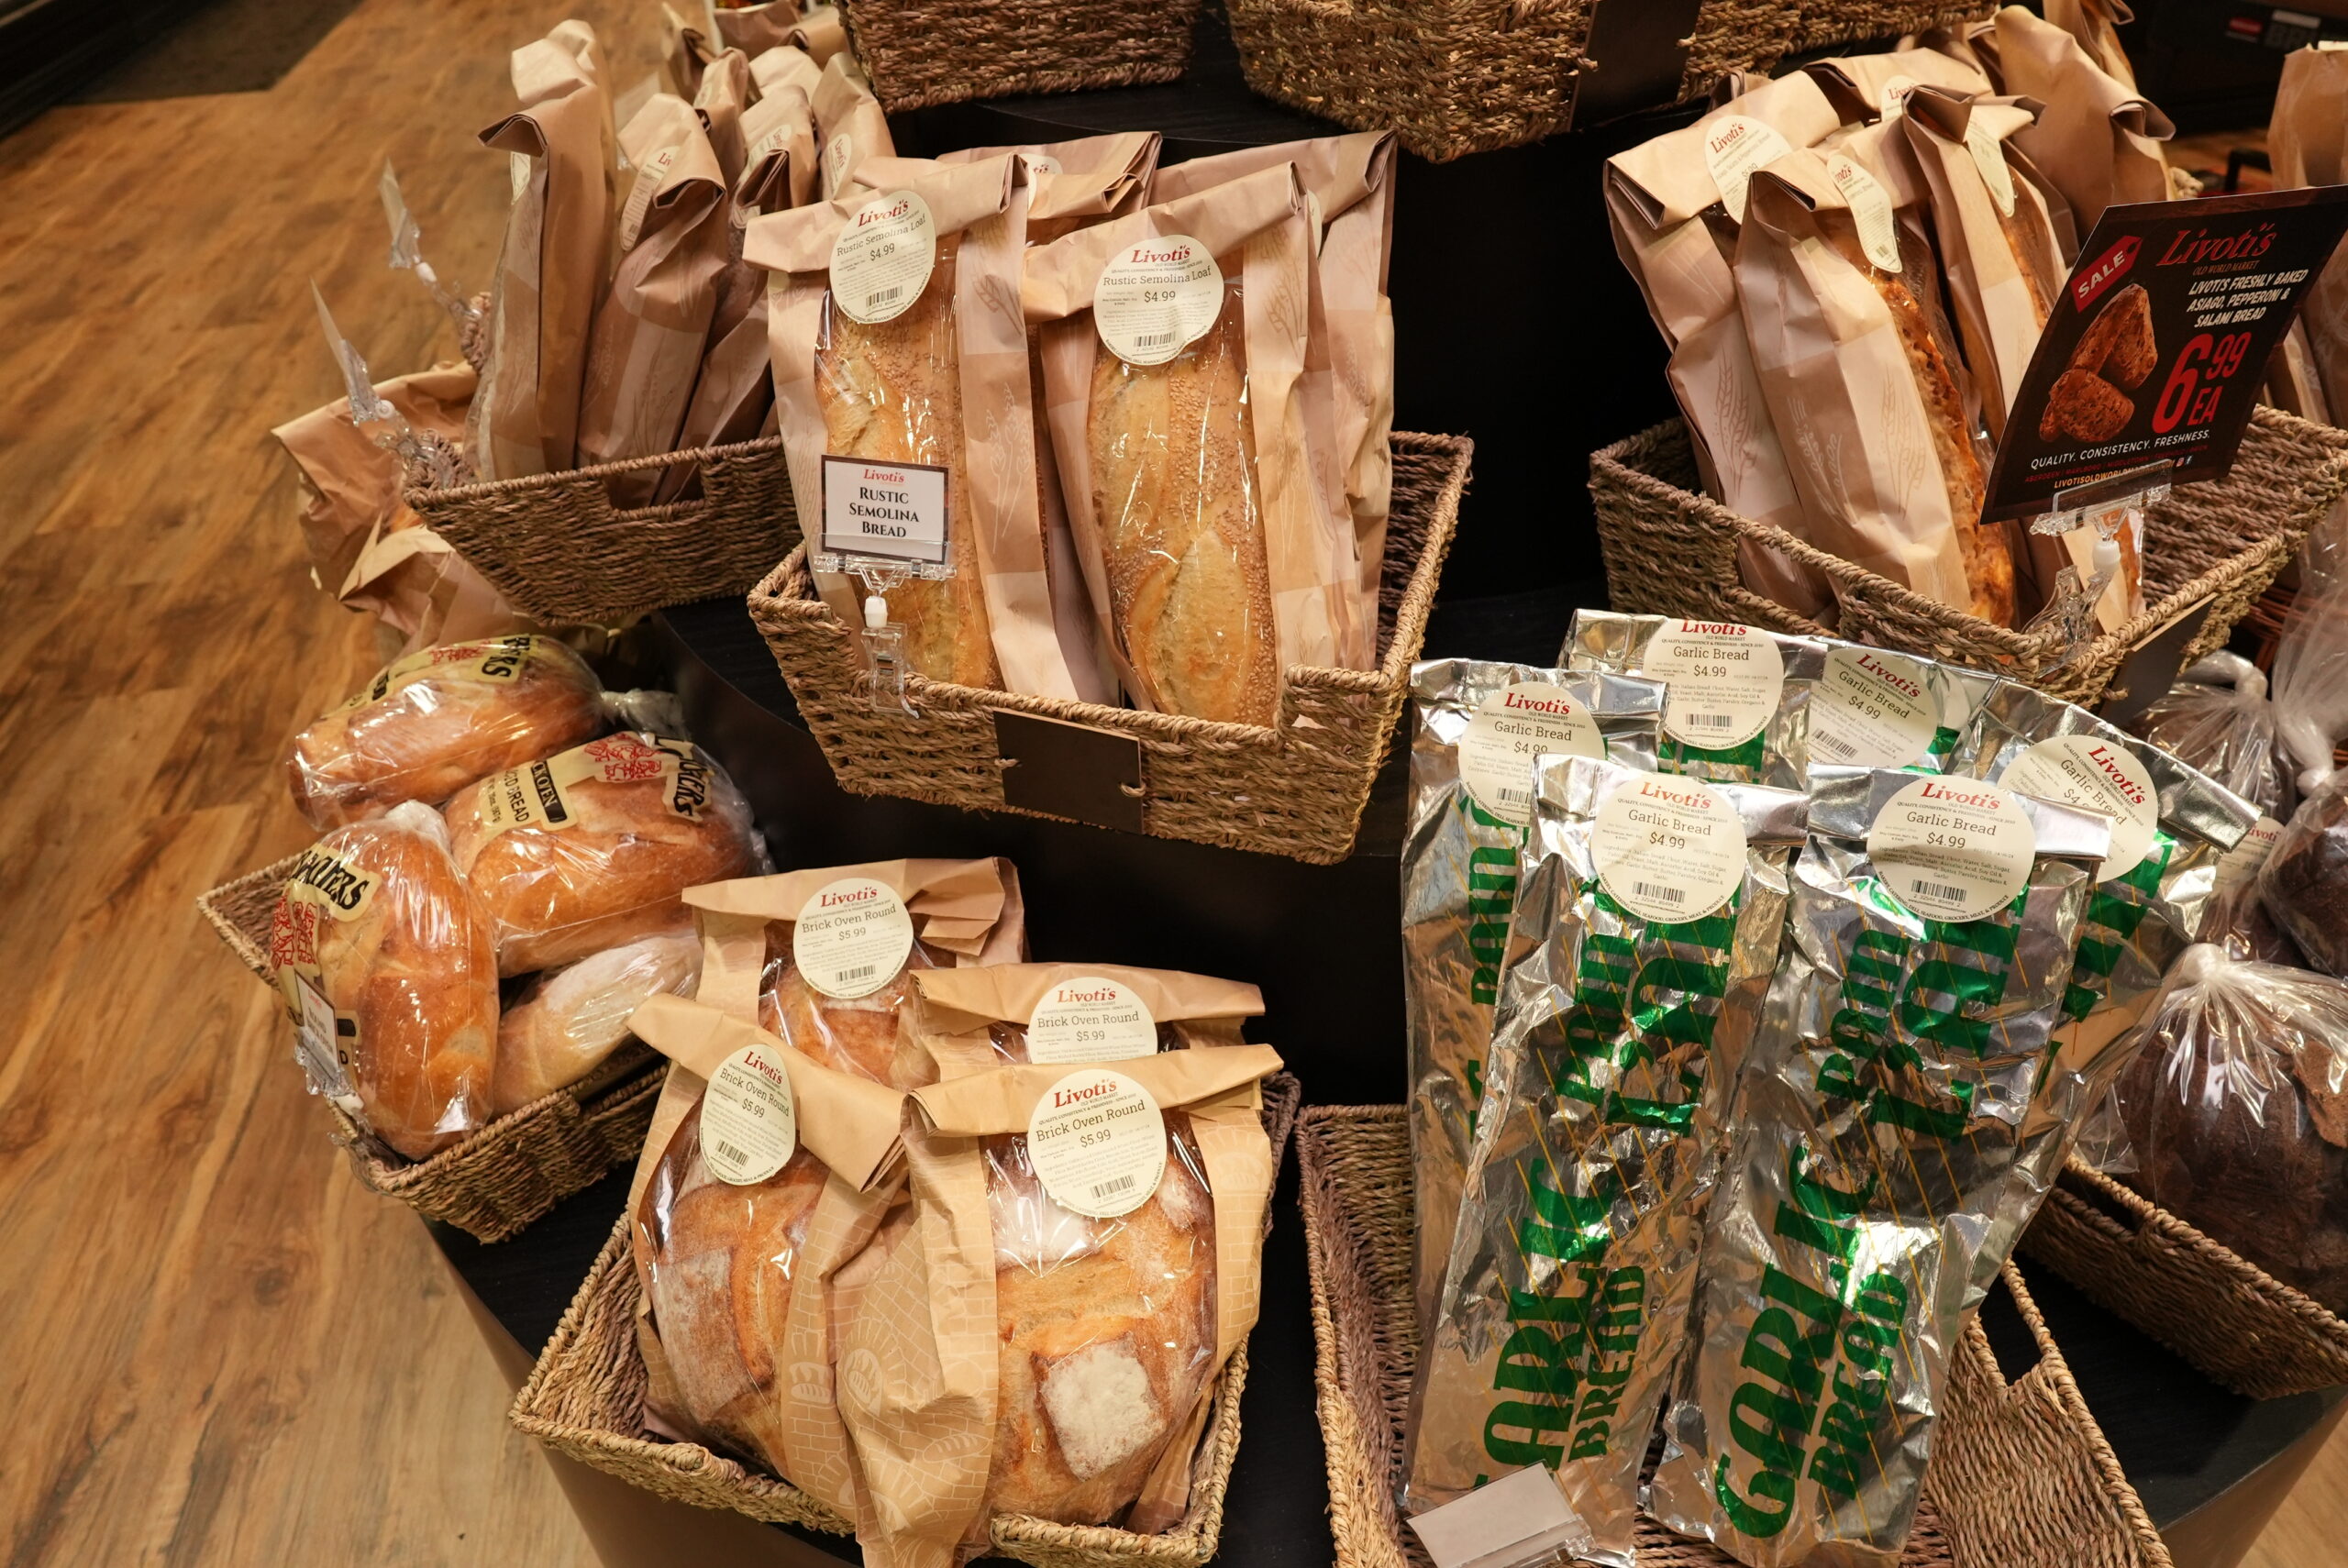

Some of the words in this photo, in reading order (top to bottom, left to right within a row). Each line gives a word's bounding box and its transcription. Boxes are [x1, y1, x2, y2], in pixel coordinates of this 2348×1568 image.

[1711, 123, 1744, 153] Livoti's
[858, 199, 908, 227] Livoti's
[837, 240, 863, 256] Rustic
[866, 227, 908, 245] Semolina
[911, 215, 926, 231] Loaf
[2156, 223, 2277, 266] Livoti's
[870, 243, 894, 261] $4.99
[1131, 245, 1191, 262] Livoti's
[1103, 277, 1136, 285] Rustic
[1140, 273, 1190, 284] Semolina
[1192, 266, 1211, 280] Loaf
[2077, 250, 2126, 299] SALE
[2188, 279, 2230, 295] LIVOTI'S
[2229, 273, 2275, 291] FRESHLY
[2274, 270, 2309, 284] BAKED
[1145, 291, 1176, 303] $4.99
[2187, 295, 2226, 312] ASIAGO,
[2227, 289, 2282, 307] PEPPERONI
[2281, 288, 2290, 299] &
[2194, 311, 2233, 327] SALAMI
[2232, 307, 2266, 323] BREAD
[2187, 385, 2222, 426] EA
[2031, 452, 2077, 469] QUALITY.
[2080, 440, 2151, 459] CONSISTENCY.
[2154, 430, 2210, 447] FRESHNESS.
[864, 469, 904, 482] Livoti's
[859, 487, 909, 503] RUSTIC
[849, 502, 919, 522] SEMOLINA
[862, 522, 906, 537] BREAD
[1674, 646, 1709, 657] Garlic
[1713, 648, 1749, 660] Bread
[1694, 665, 1726, 677] $4.99
[1856, 654, 1921, 699] Livoti's
[1504, 692, 1570, 714] Livoti's
[1839, 671, 1873, 697] Garlic
[1874, 693, 1910, 719] Bread
[1849, 696, 1880, 719] $4.99
[1495, 722, 1531, 736] Garlic
[1536, 725, 1571, 741] Bread
[2061, 759, 2093, 792] Garlic
[2088, 745, 2145, 804] Livoti's
[1640, 781, 1711, 809] Livoti's
[1921, 782, 2000, 810] Livoti's
[1629, 809, 1668, 827] Garlic
[1673, 819, 1711, 835] Bread
[1907, 812, 1949, 827] Garlic
[1954, 818, 1996, 835] Bread
[1650, 832, 1685, 849] $4.99
[1926, 832, 1966, 848] $4.99
[821, 887, 877, 907] Livoti's
[803, 920, 831, 933] Brick
[835, 916, 861, 926] Oven
[865, 904, 896, 921] Round
[839, 927, 866, 941] $5.99
[1058, 988, 1115, 1003] Livoti's
[1037, 1016, 1069, 1028] Brick
[1071, 1015, 1099, 1025] Oven
[1103, 1011, 1139, 1023] Round
[1077, 1031, 1104, 1042] $5.99
[744, 1051, 782, 1085] Livoti's
[720, 1068, 743, 1088] Brick
[747, 1083, 767, 1100] Oven
[768, 1096, 789, 1117] Round
[1055, 1079, 1116, 1108] Livoti's
[742, 1099, 765, 1118] $5.99
[1036, 1123, 1069, 1142] Brick
[1073, 1114, 1103, 1130] Oven
[1106, 1100, 1146, 1121] Round
[1080, 1130, 1112, 1148] $5.99
[1475, 1159, 1614, 1489] ARLIC
[1715, 1143, 1877, 1538] GARLIC
[1568, 1265, 1645, 1463] BREAD
[1808, 1272, 1908, 1501] BREAD
